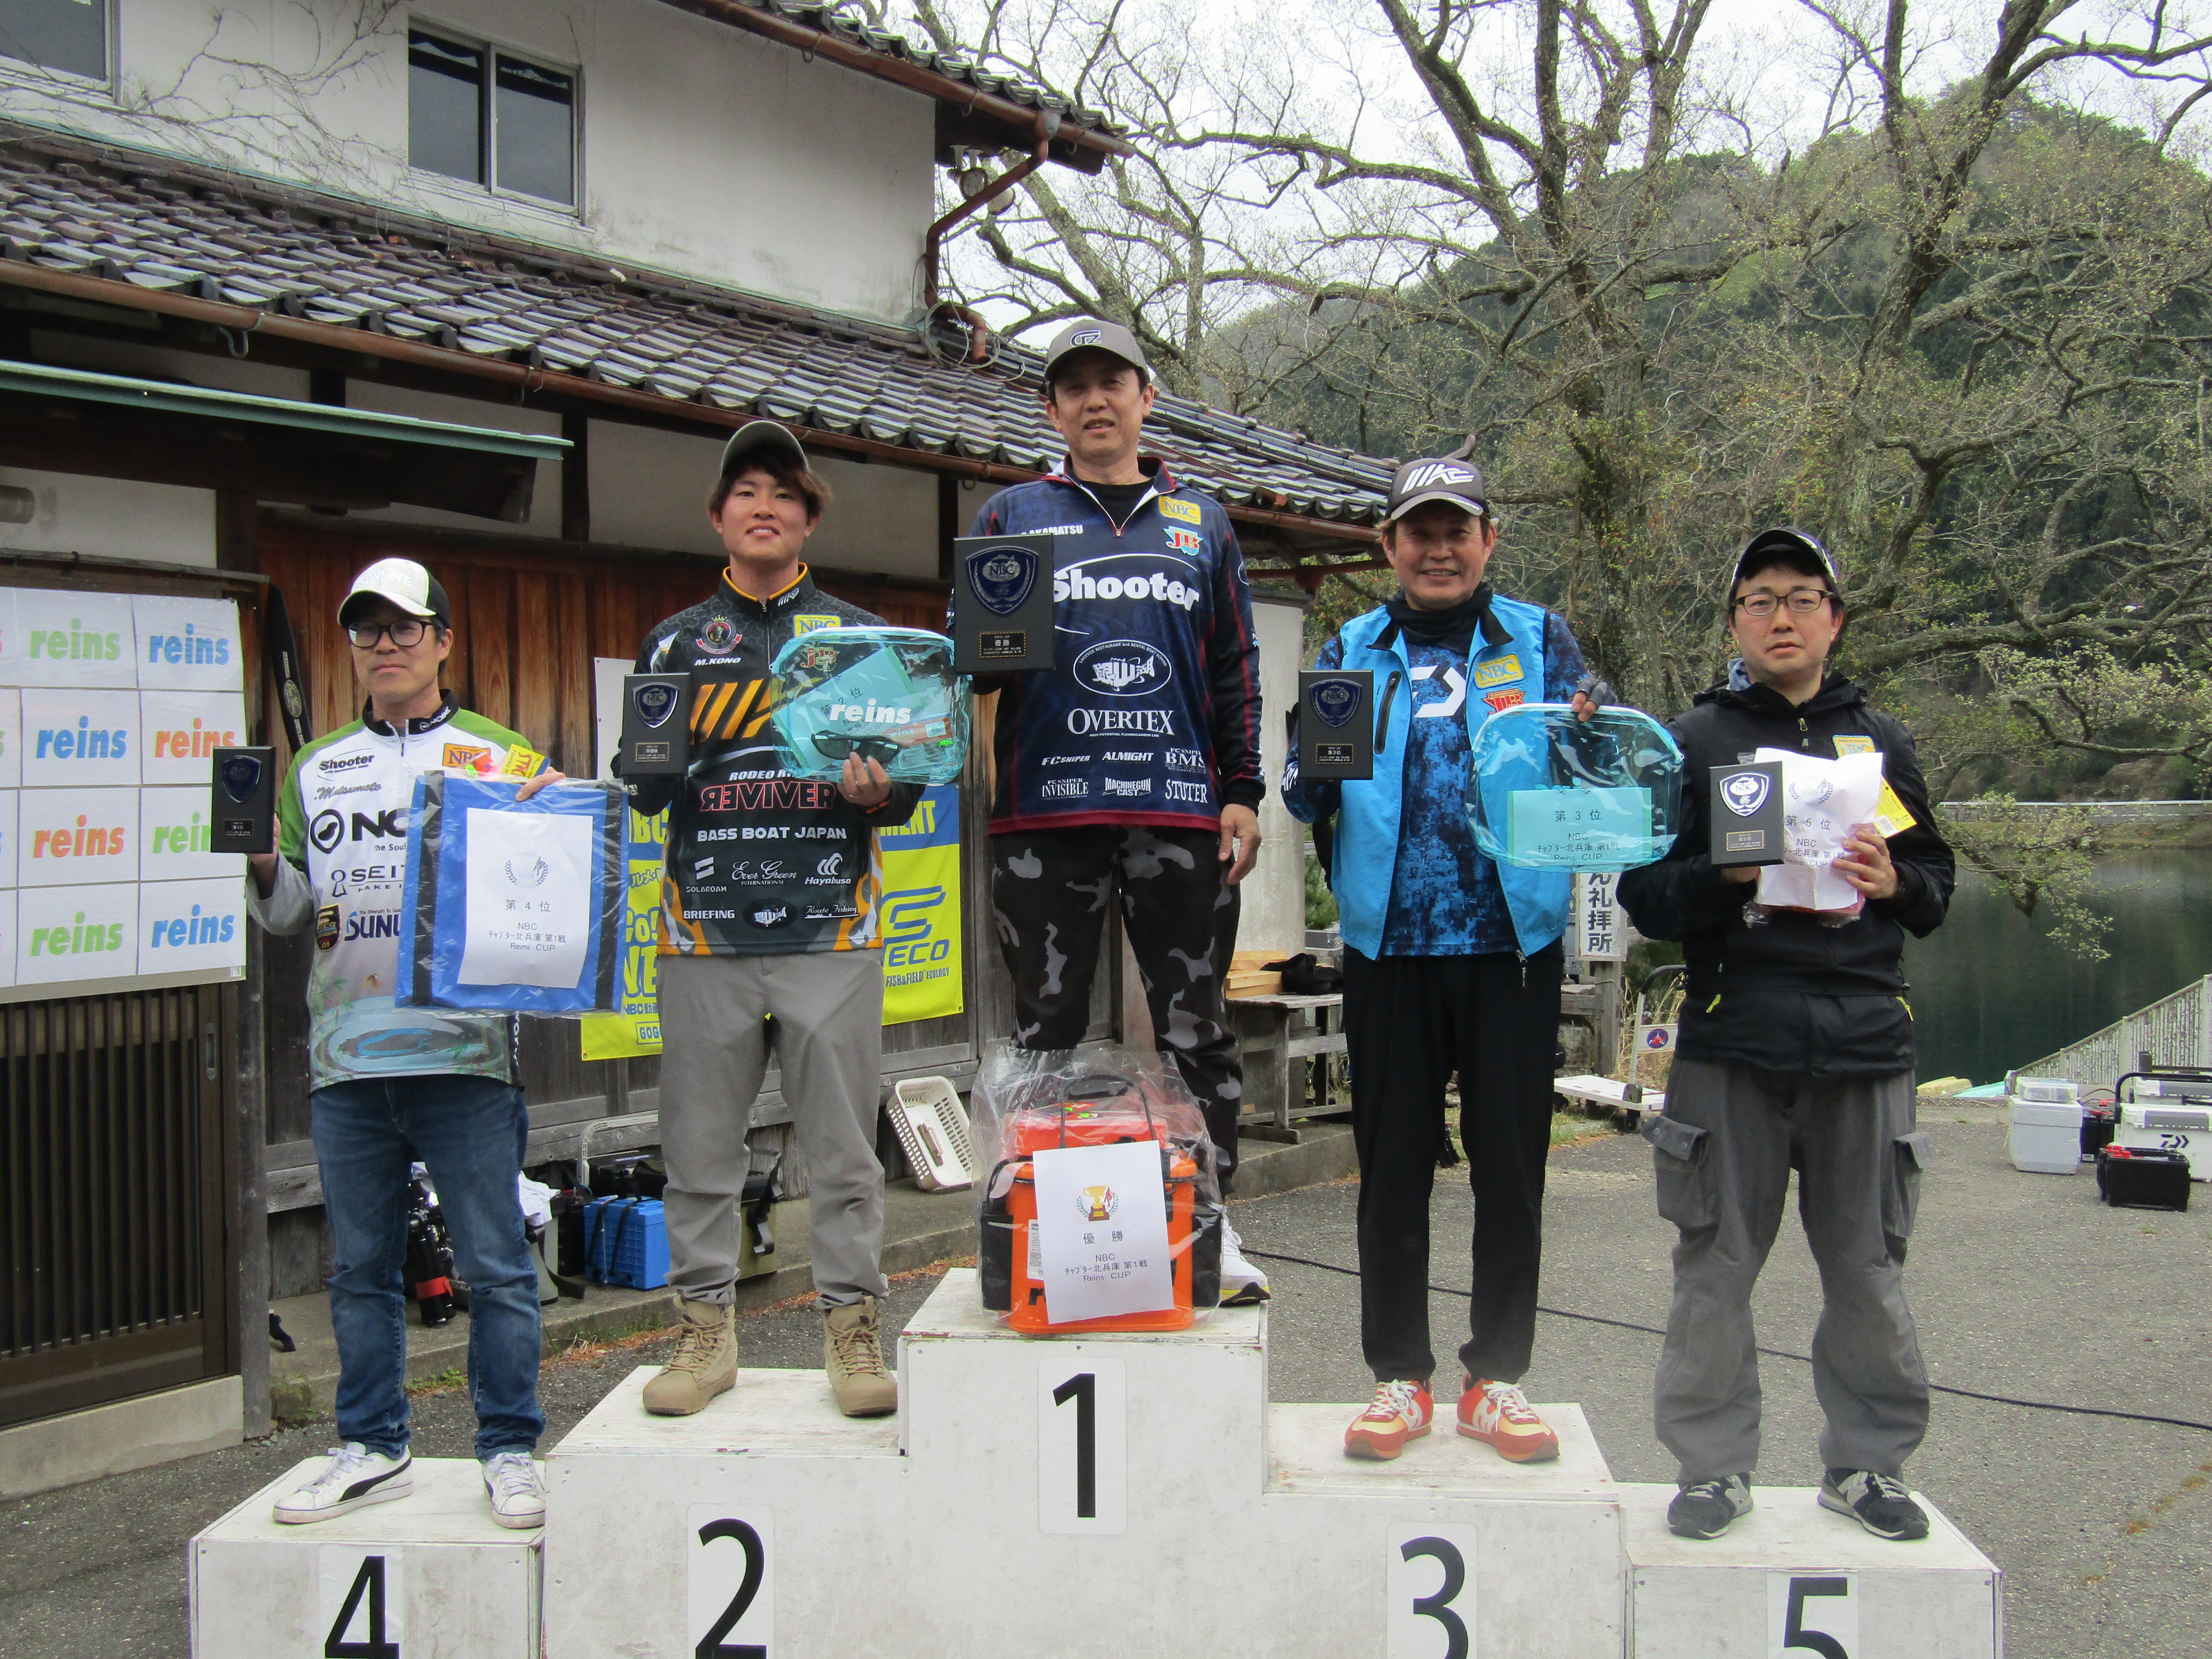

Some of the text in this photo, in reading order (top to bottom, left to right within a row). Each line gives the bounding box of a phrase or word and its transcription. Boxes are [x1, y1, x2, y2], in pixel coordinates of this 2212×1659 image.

[1164, 501, 1197, 519] NBC
[989, 564, 1015, 576] NBC
[1054, 568, 1200, 611] Shooter
[30, 617, 120, 661] reins
[148, 623, 229, 666] reins
[1095, 642, 1121, 652] RESTAURANT
[694, 657, 742, 666] M.KONO
[1477, 660, 1519, 681] NBC
[830, 698, 911, 723] reins
[1067, 708, 1175, 736] OVERTEX
[36, 715, 127, 759] reins
[155, 717, 235, 758] reins
[319, 754, 375, 771] Shooter
[507, 749, 517, 770] FISHING
[1102, 751, 1155, 762] ALMIGHT
[729, 770, 775, 781] RODEO
[1105, 777, 1151, 792] MACHINEGUN
[1042, 782, 1089, 797] INVISIBLE
[1165, 779, 1208, 804] STUTER
[1735, 783, 1753, 791] NBC
[33, 814, 125, 859] reins
[152, 811, 212, 854] rei
[698, 826, 847, 842] BASS BOAT JAPAN
[1796, 838, 1817, 848] NBC
[732, 860, 797, 881] Ever Green
[805, 876, 851, 887] Hayabusa
[684, 909, 736, 920] BRIEFING
[832, 904, 857, 915] Fishing
[30, 911, 123, 957] reins
[152, 904, 235, 948] reins
[518, 922, 538, 930] NBC
[510, 942, 531, 951] Reins
[545, 933, 566, 943] 第1戦
[889, 939, 950, 967] ECO
[927, 966, 949, 980] ECOLOGY
[1095, 1253, 1115, 1262] NBC
[1124, 1259, 1148, 1270] 第1戦
[1083, 1270, 1131, 1282] Reins CUP
[1052, 1373, 1097, 1518] 1
[695, 1518, 768, 1658] 2
[325, 1555, 399, 1658] 4
[1400, 1536, 1469, 1659] 3
[1784, 1577, 1850, 1659] 5
